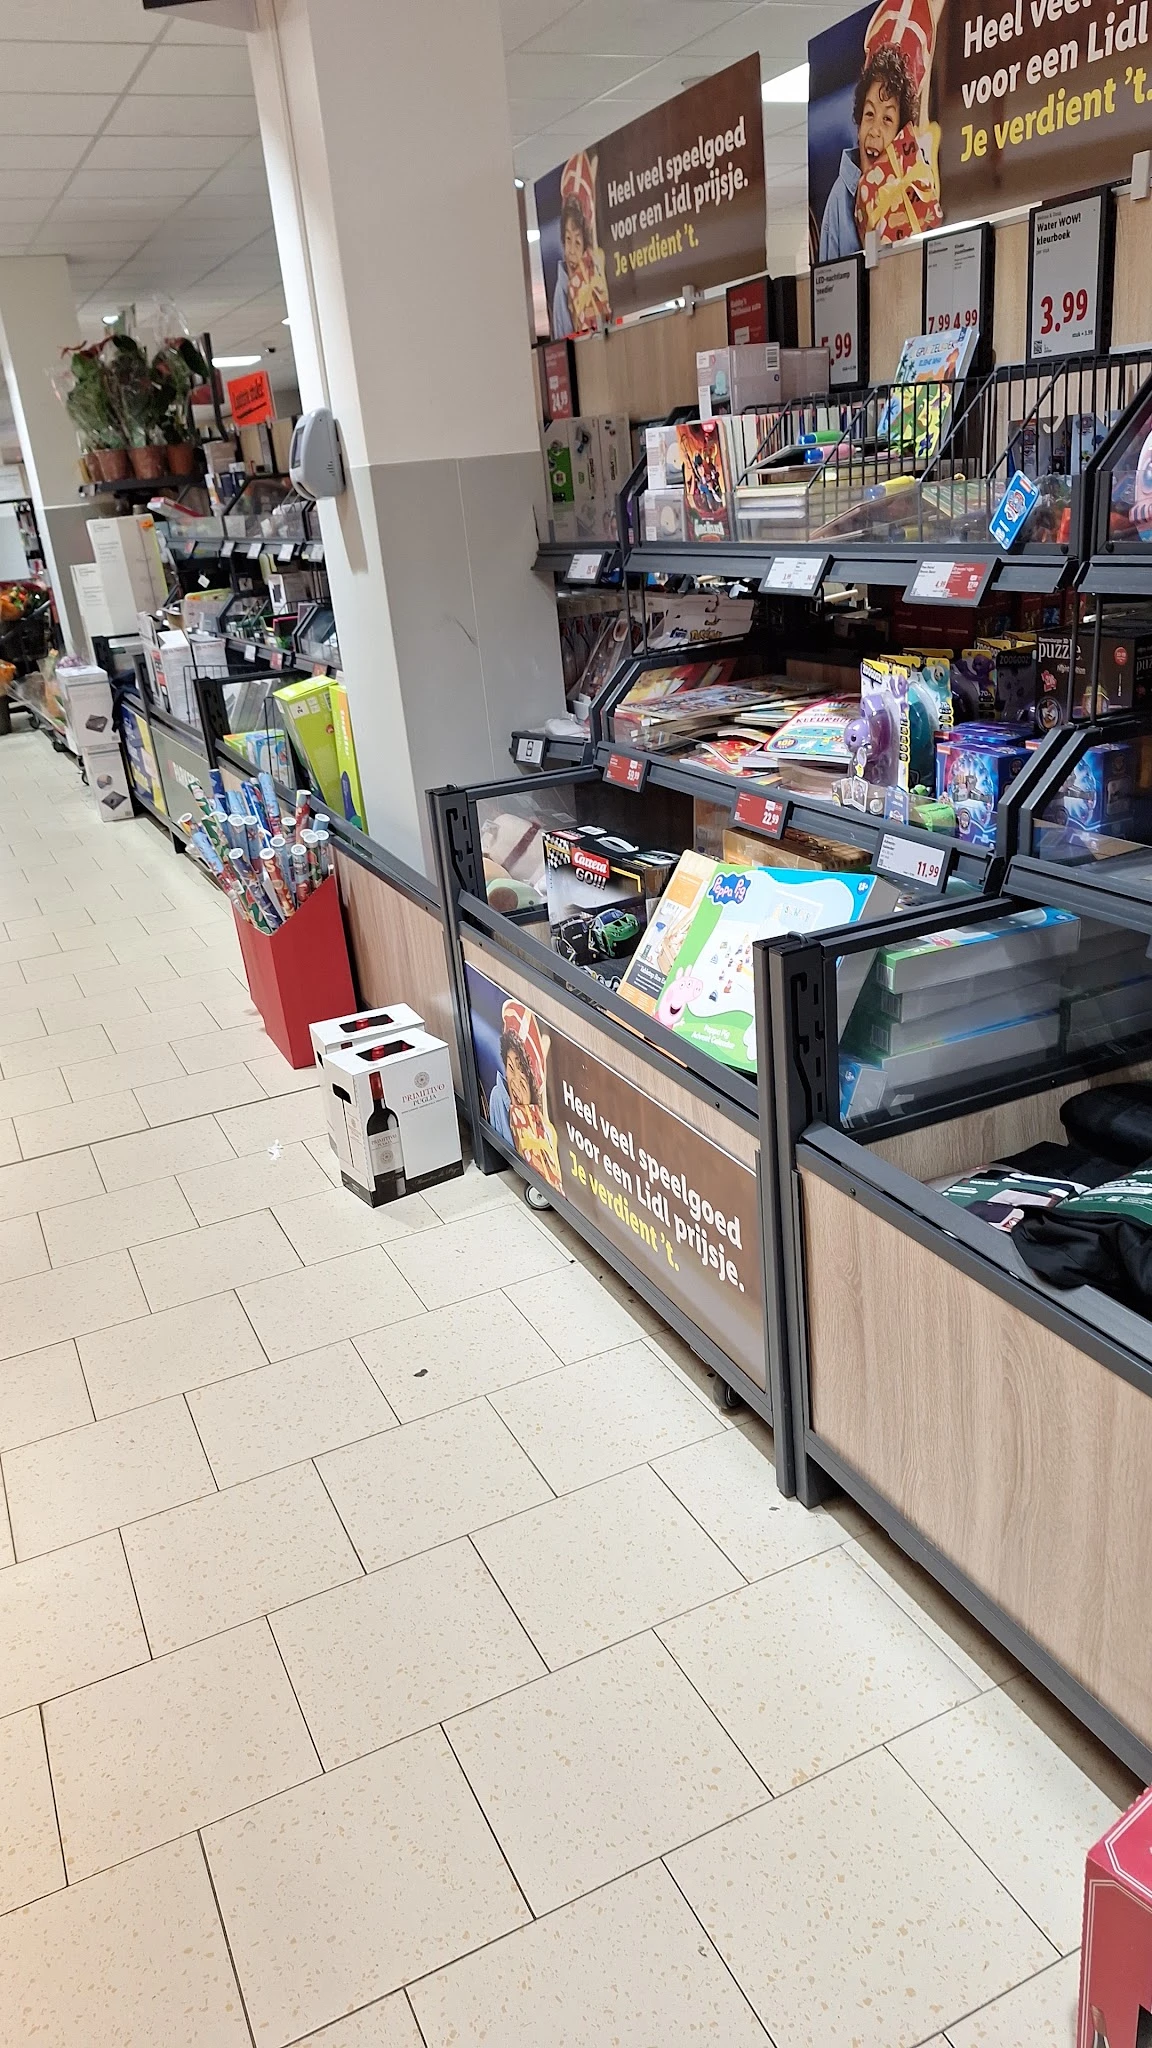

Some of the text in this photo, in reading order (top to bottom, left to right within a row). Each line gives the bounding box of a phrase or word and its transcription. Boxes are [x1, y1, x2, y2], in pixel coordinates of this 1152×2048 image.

[964, 0, 1092, 58] Heel vee
[962, 1, 1148, 109] voor een Lidl
[960, 124, 988, 162] Je
[994, 78, 1116, 150] verdient
[608, 116, 746, 208] Heel veel speelgoed
[610, 162, 748, 241] voor een Lidl prijsje.
[1036, 229, 1071, 246] kleurboek
[1037, 212, 1082, 232] Water WOW!
[614, 252, 627, 276] Je
[630, 229, 682, 270] verdient
[928, 314, 950, 334] 7.99
[1040, 288, 1088, 334] 3.99
[762, 810, 780, 827] 22.99
[574, 852, 607, 874] Carrera
[576, 868, 606, 890] GO!!!
[917, 862, 940, 878] 11.99
[712, 876, 733, 900] Peppa
[734, 878, 747, 900] Pig
[402, 1084, 446, 1103] PRIMITIVO
[413, 1094, 436, 1106] PUGLIA
[562, 1080, 742, 1250] Heel veel speelgoed
[566, 1121, 744, 1292] voor een Lidl prijsje.
[569, 1150, 586, 1186] Je
[589, 1174, 658, 1252] verdient
